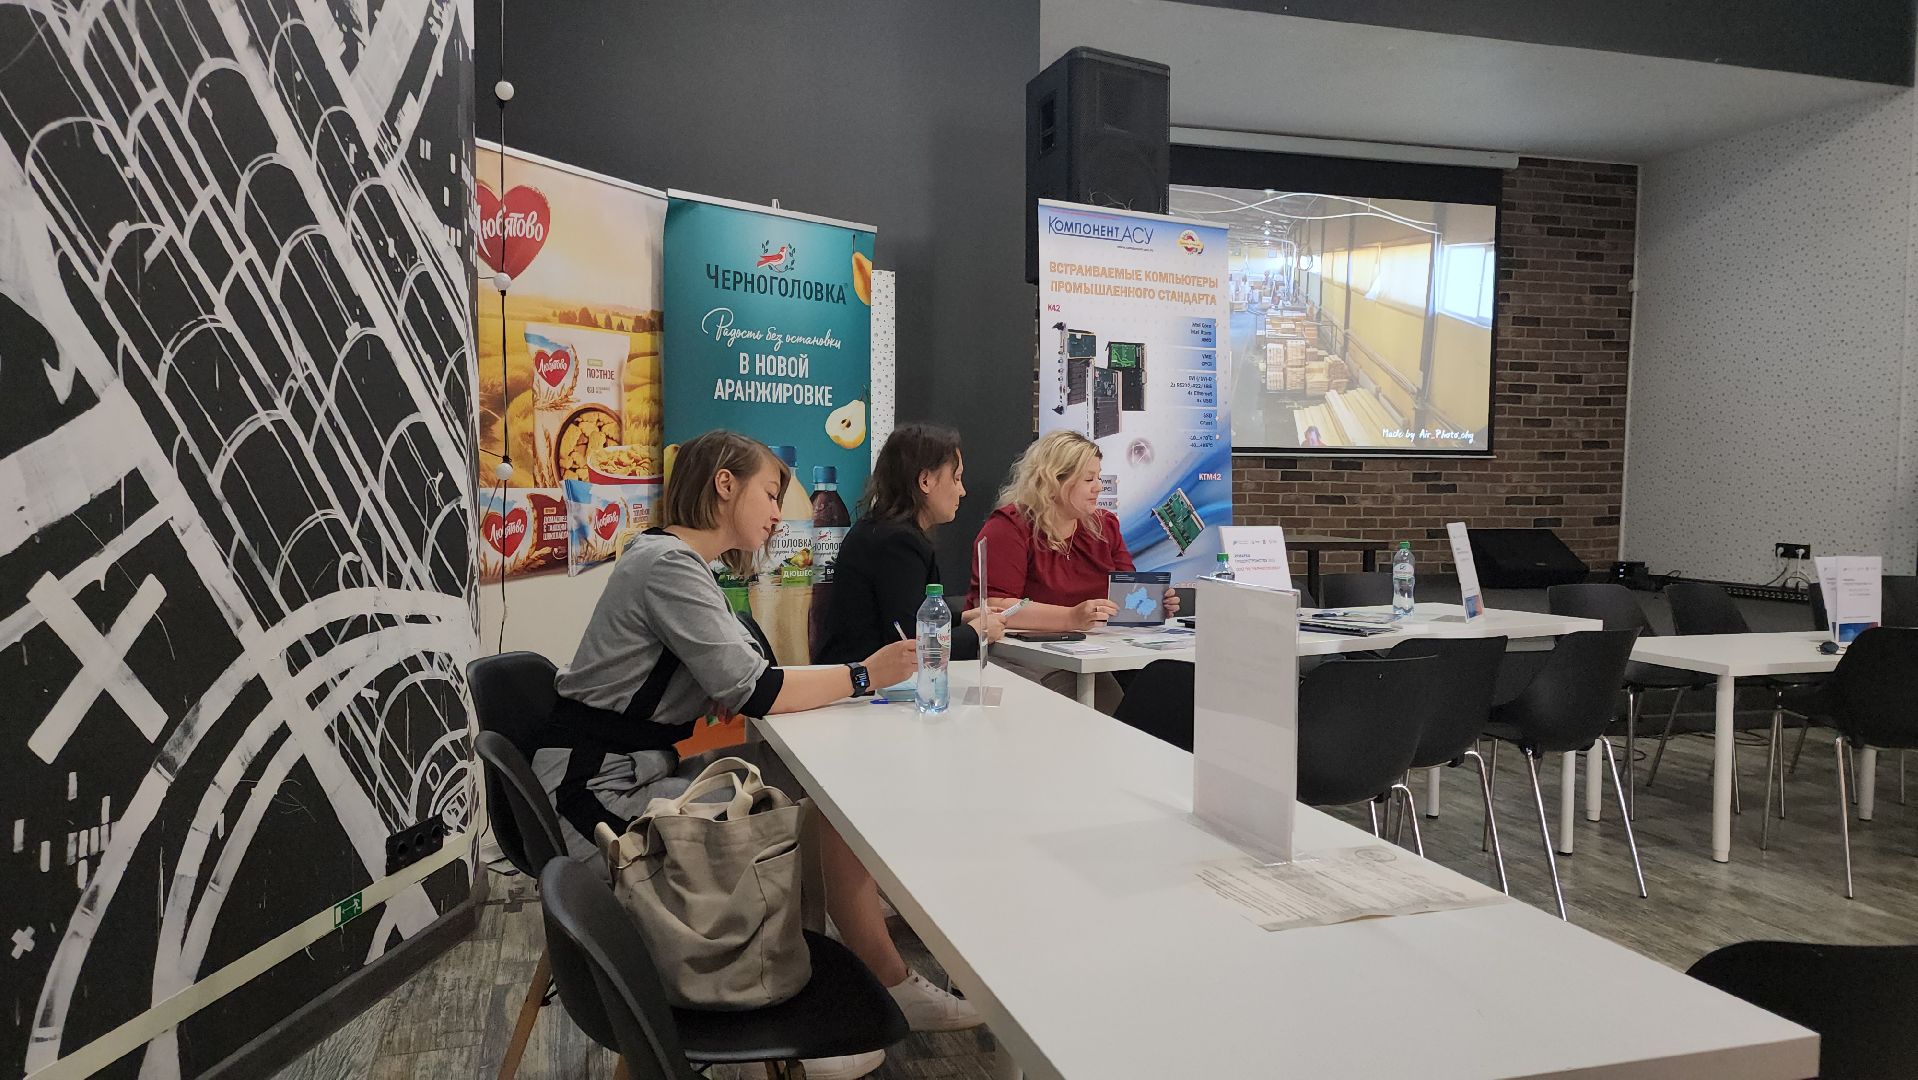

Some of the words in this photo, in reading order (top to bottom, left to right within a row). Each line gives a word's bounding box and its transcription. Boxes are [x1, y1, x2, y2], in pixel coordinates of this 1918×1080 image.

[1120, 225, 1154, 245] АСУ
[706, 263, 847, 305] ЧЕРНОГОЛОВКА
[1049, 261, 1143, 281] ВСТРАИВАЕМЫЕ
[1144, 270, 1218, 289] КОМПЬЮТЕРЫ
[1050, 280, 1156, 300] ПРОМЫШЛЕННОГО
[1157, 289, 1217, 306] СТАНДАРТА
[701, 307, 763, 348] Радость
[765, 326, 783, 352] без
[785, 329, 842, 350] остановки
[739, 352, 750, 375] В
[755, 353, 809, 379] НОВОЙ
[714, 378, 833, 407] АРАНЖИРОВКЕ
[1382, 429, 1404, 438] Made
[1405, 429, 1416, 442] by
[783, 569, 813, 579] ДЮШЕС
